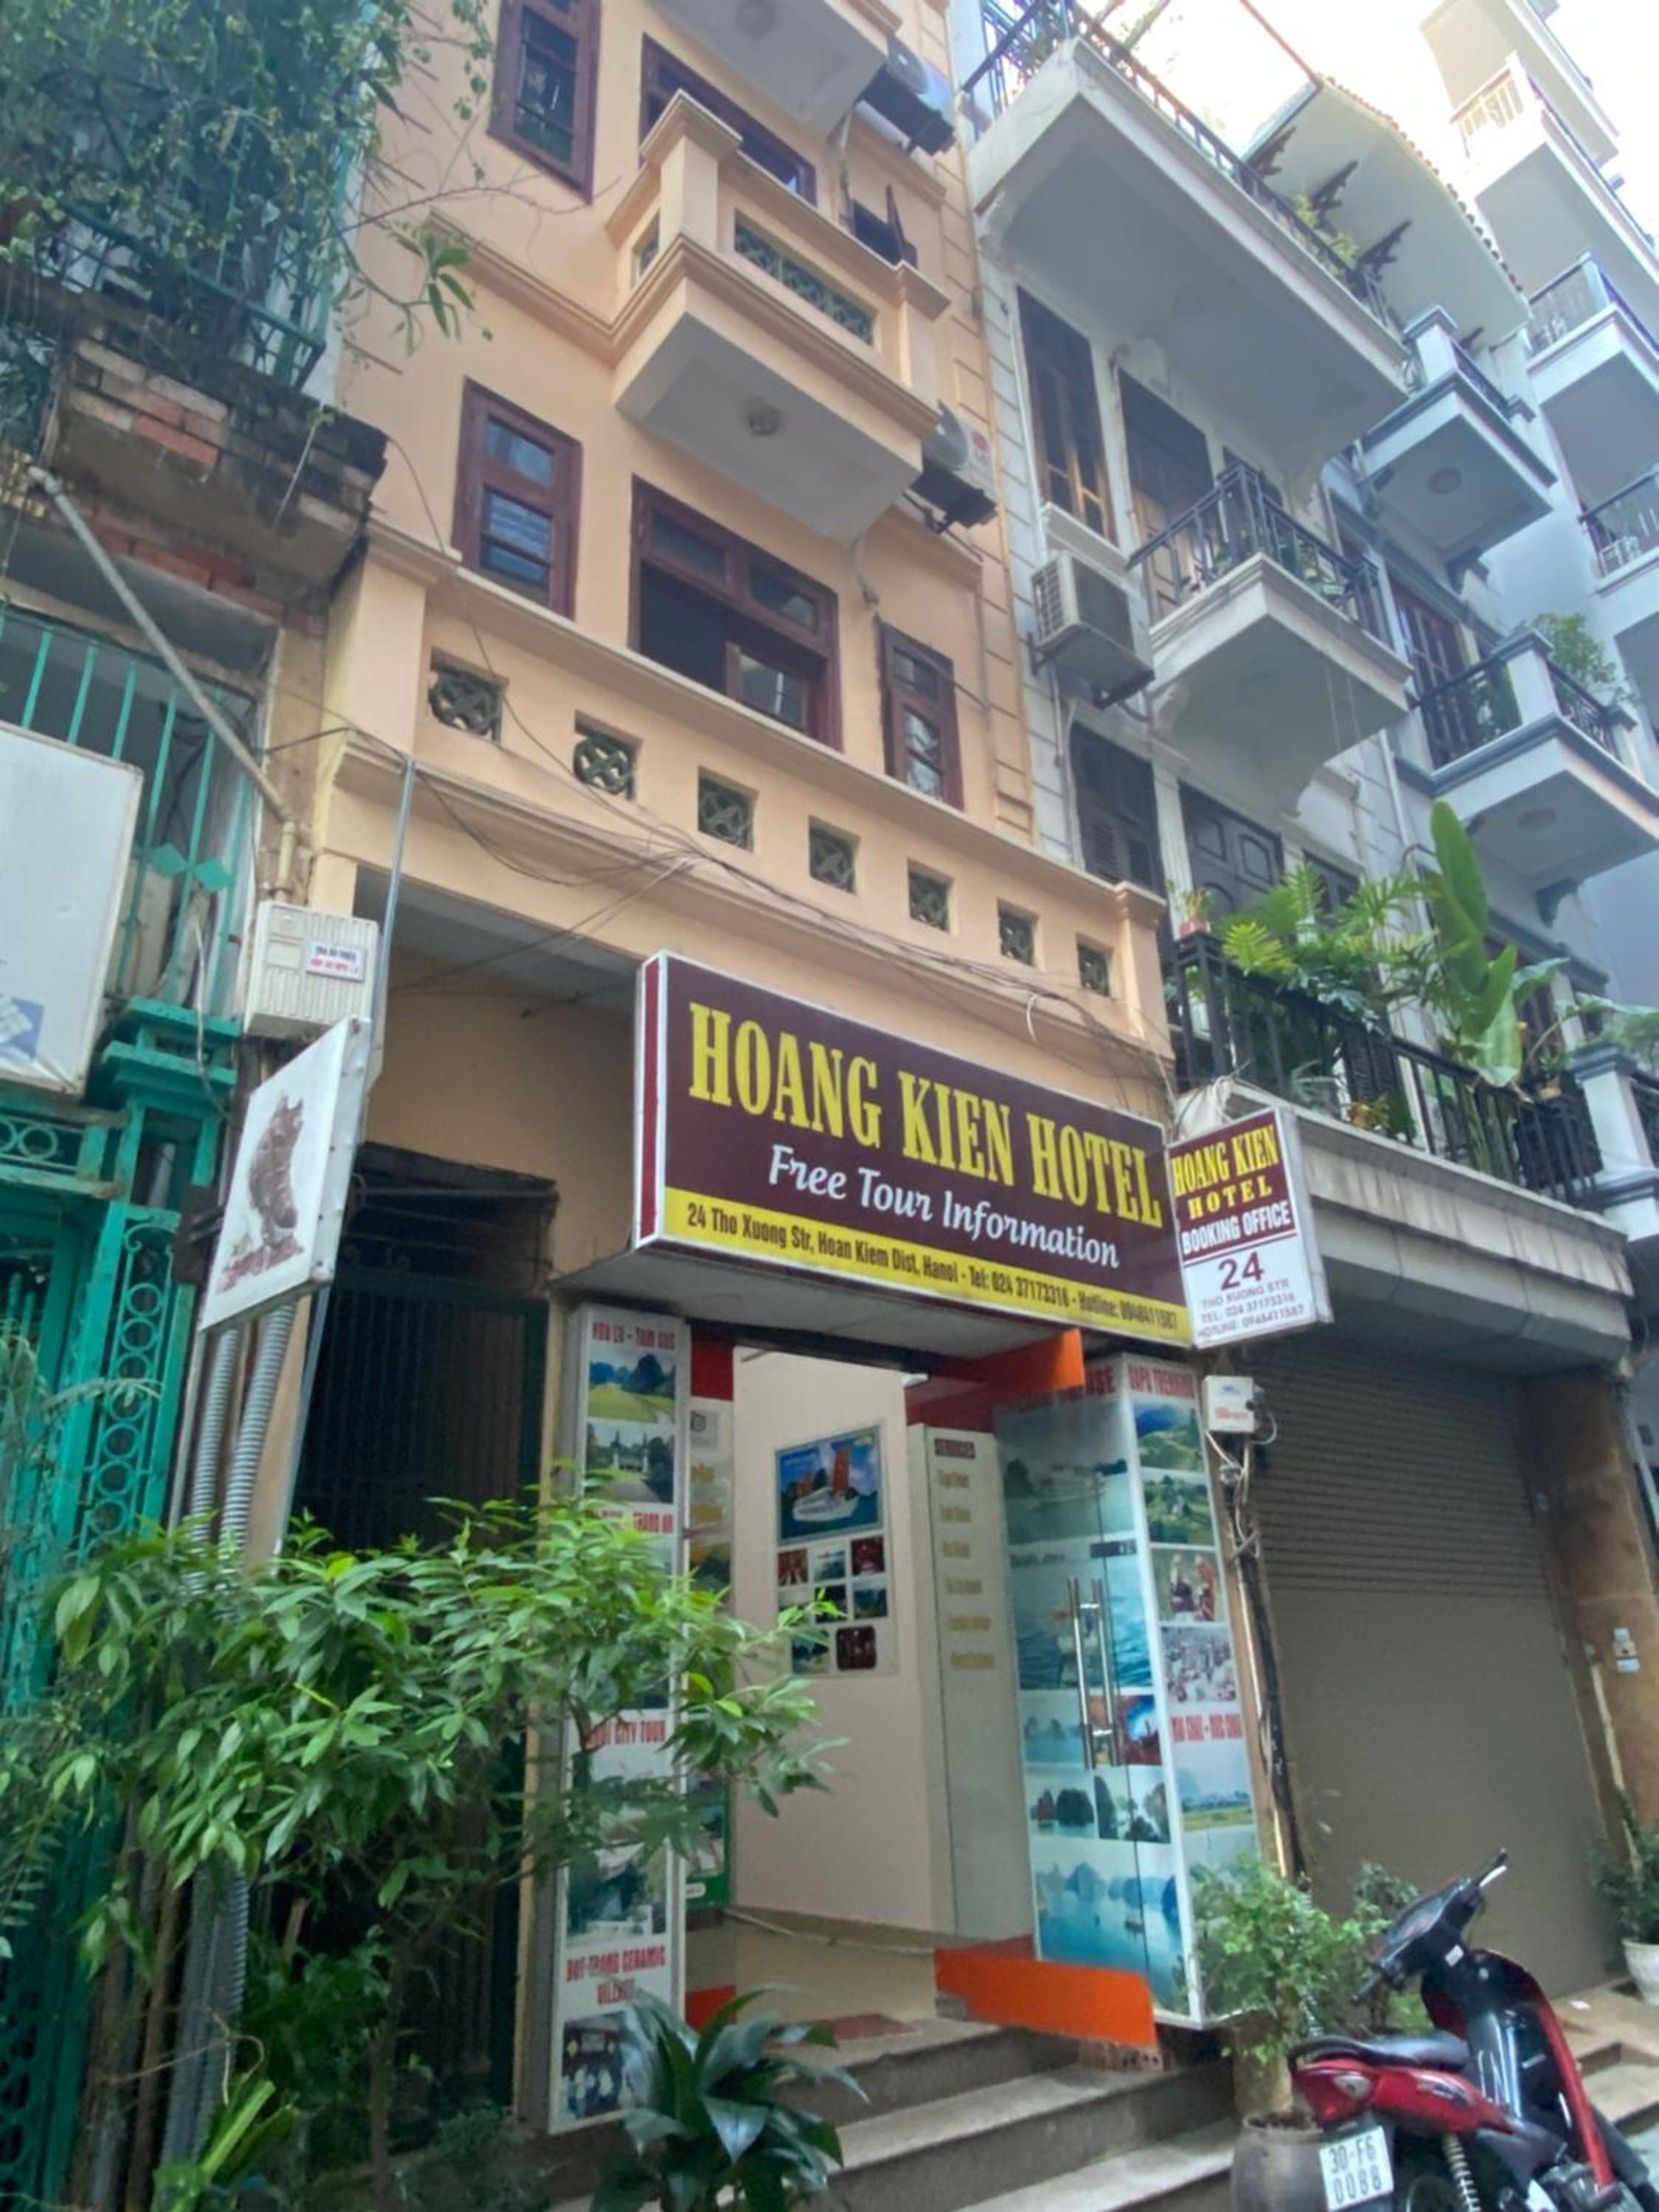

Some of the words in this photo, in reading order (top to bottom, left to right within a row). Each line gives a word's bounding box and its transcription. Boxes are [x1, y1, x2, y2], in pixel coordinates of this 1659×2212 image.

[689, 1002, 882, 1149] HOANG
[897, 1070, 1015, 1186] KIEN
[1026, 1111, 1163, 1228] HOTEL
[1172, 1142, 1231, 1197] HOANG
[1231, 1124, 1279, 1177] KIEN
[768, 1144, 847, 1201] Free
[858, 1166, 933, 1222] Tour
[943, 1190, 1121, 1269] Information
[1187, 1175, 1273, 1220] HOTEL
[687, 1202, 706, 1229] 24
[711, 1207, 737, 1236] Tho
[742, 1214, 787, 1249] Xuong
[818, 1231, 852, 1261] Hoan
[855, 1239, 889, 1269] Kiem
[923, 1255, 958, 1284] Hanoi
[967, 1265, 992, 1291] Tel:
[992, 1270, 1014, 1295] 024
[1181, 1215, 1242, 1254] BOOKING
[1242, 1200, 1292, 1237] OFFICE
[1218, 1251, 1265, 1291] 24
[1202, 1295, 1225, 1309] THO
[1332, 2163, 1382, 2204] 0088
